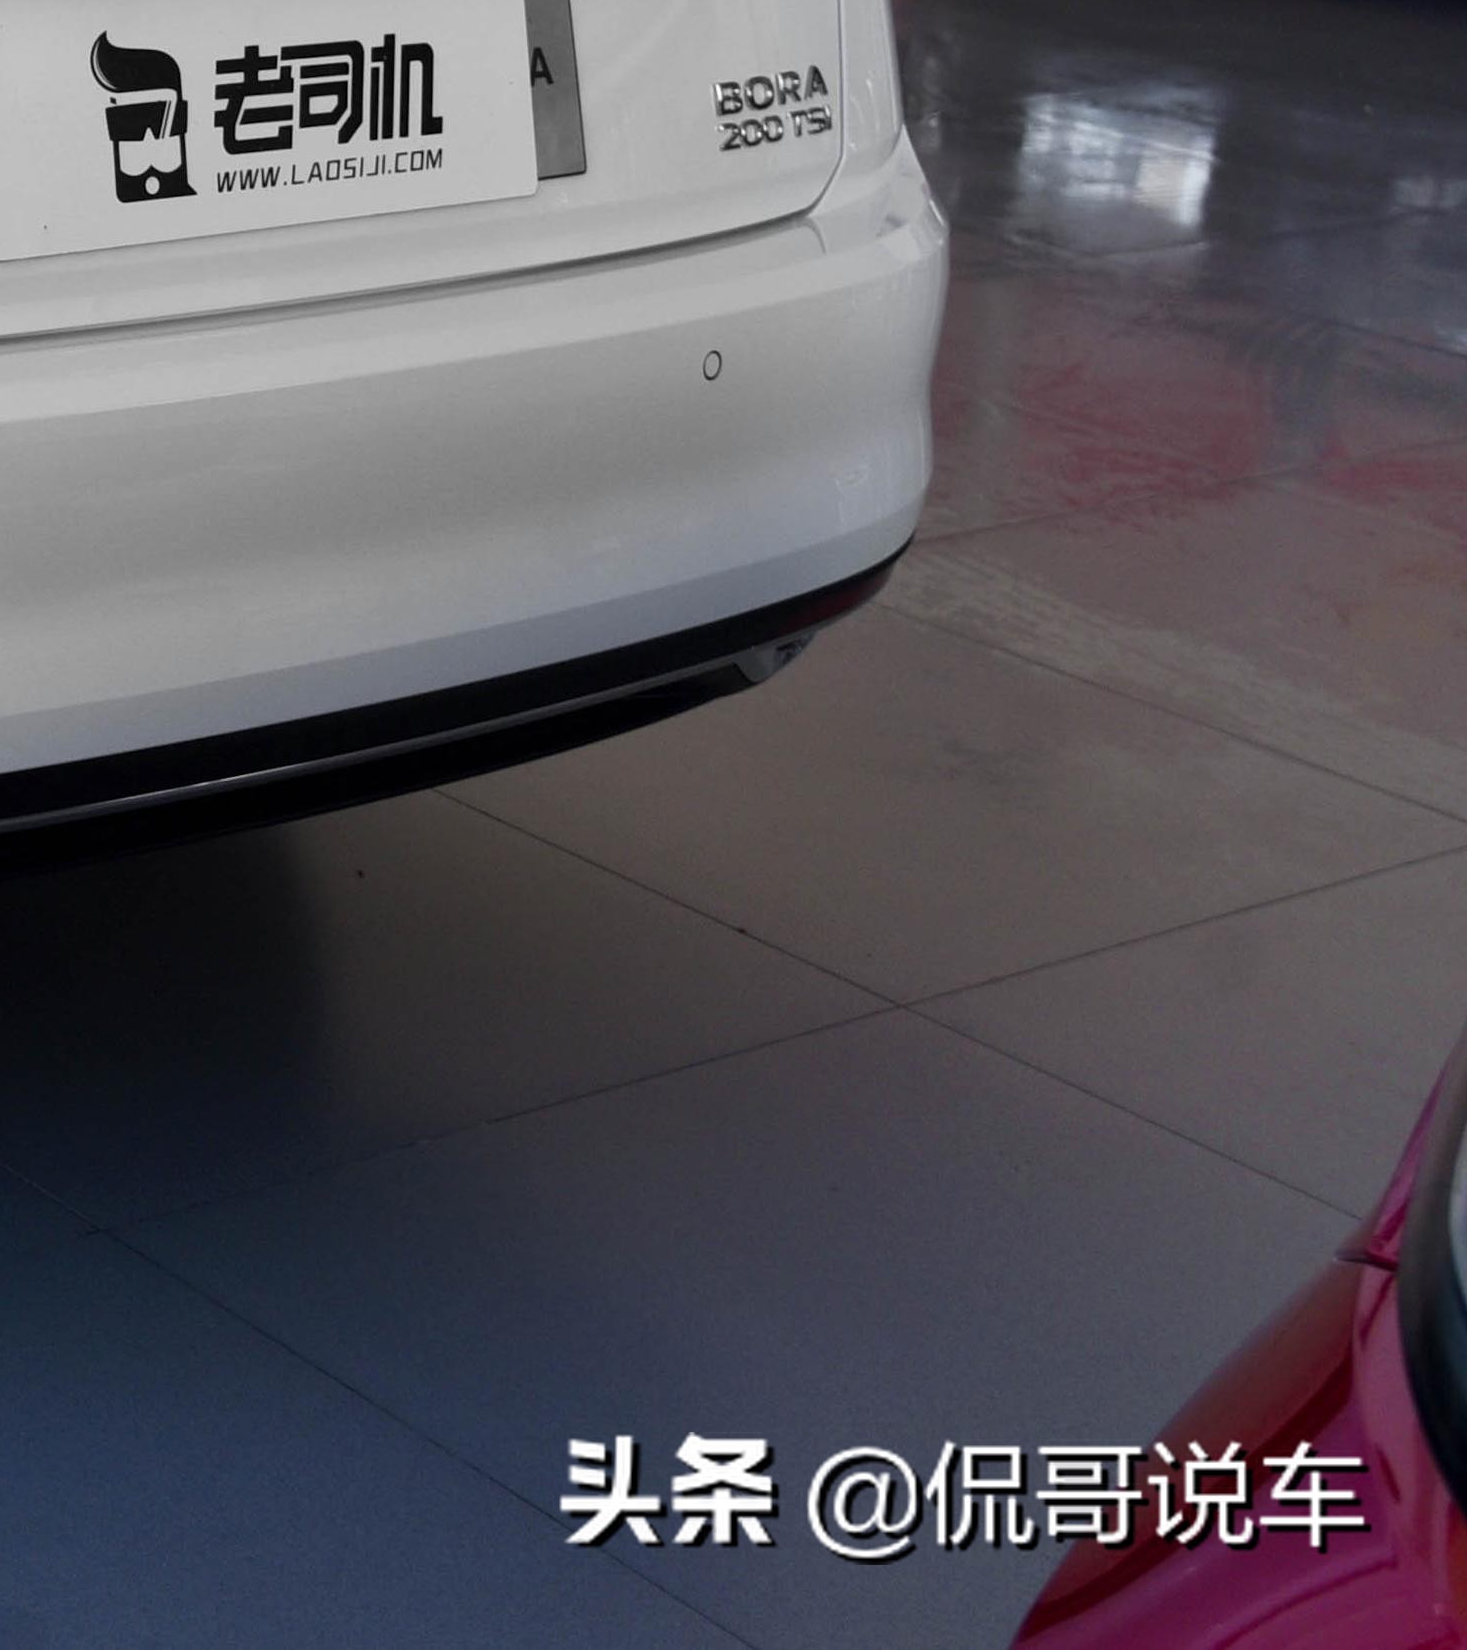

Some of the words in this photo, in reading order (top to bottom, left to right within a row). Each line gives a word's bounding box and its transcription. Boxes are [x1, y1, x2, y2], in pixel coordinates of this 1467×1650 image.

[530, 46, 554, 87] A
[213, 33, 444, 155] 老司机
[712, 64, 829, 117] BORA
[716, 115, 784, 152] 200
[216, 147, 443, 194] WWW.LAOSIJI.COM
